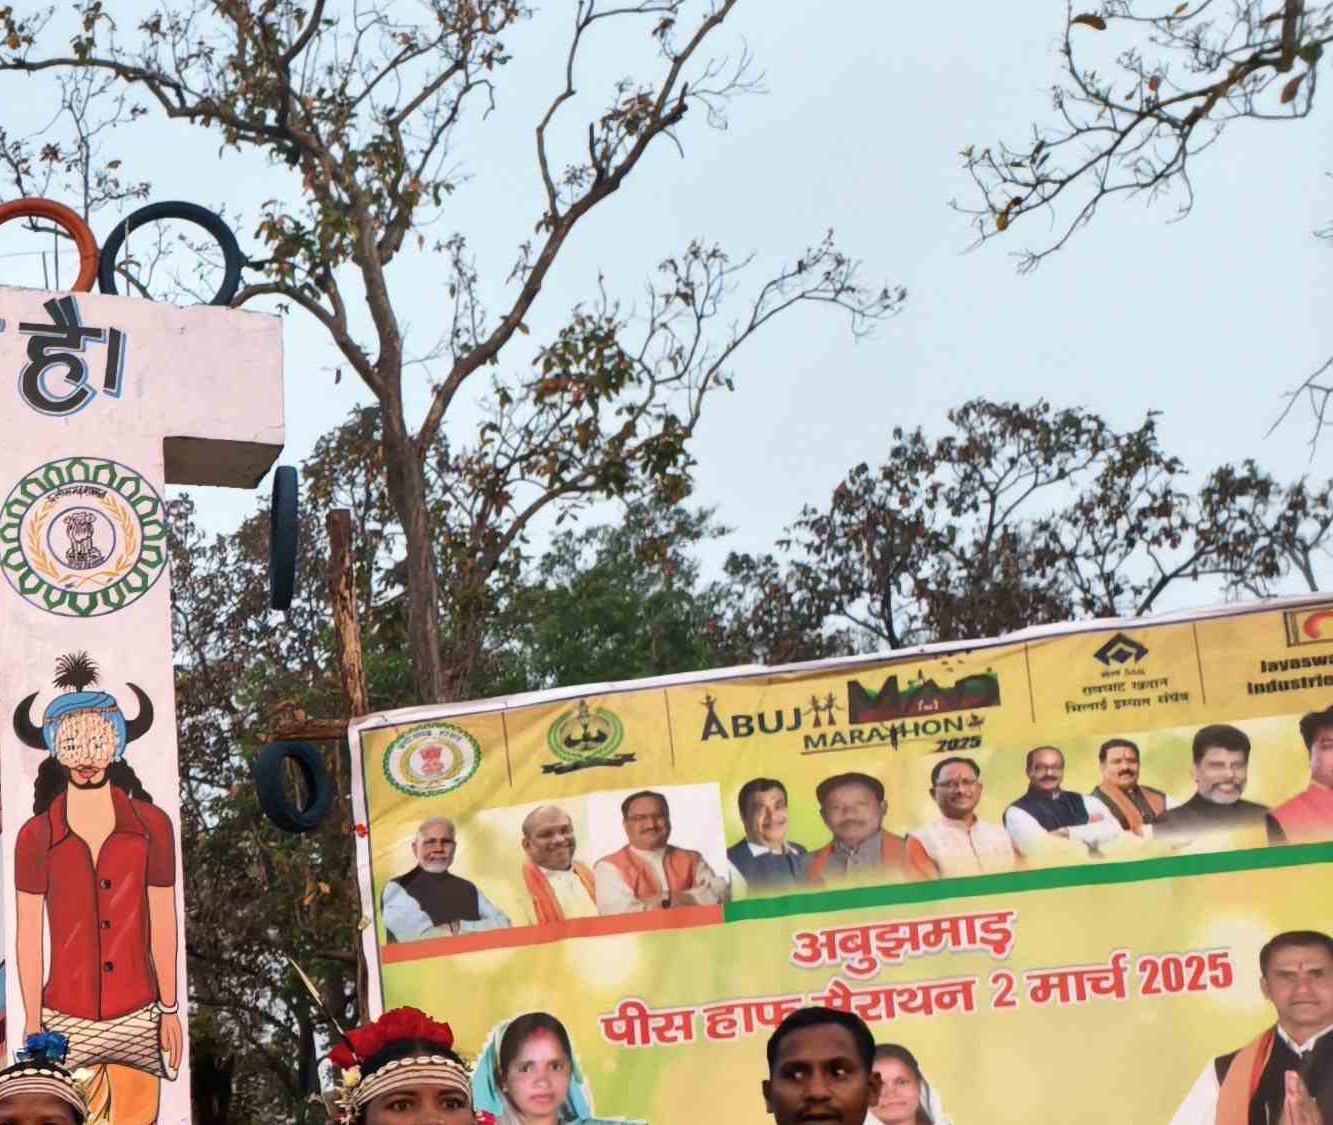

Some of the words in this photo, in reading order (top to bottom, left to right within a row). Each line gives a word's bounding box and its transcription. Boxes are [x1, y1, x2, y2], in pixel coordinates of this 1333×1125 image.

[935, 734, 982, 753] 2025
[600, 1000, 696, 1046] पीस
[992, 973, 1017, 1008] 2
[1026, 952, 1128, 1004] मार्च
[1139, 951, 1234, 995] 2025
